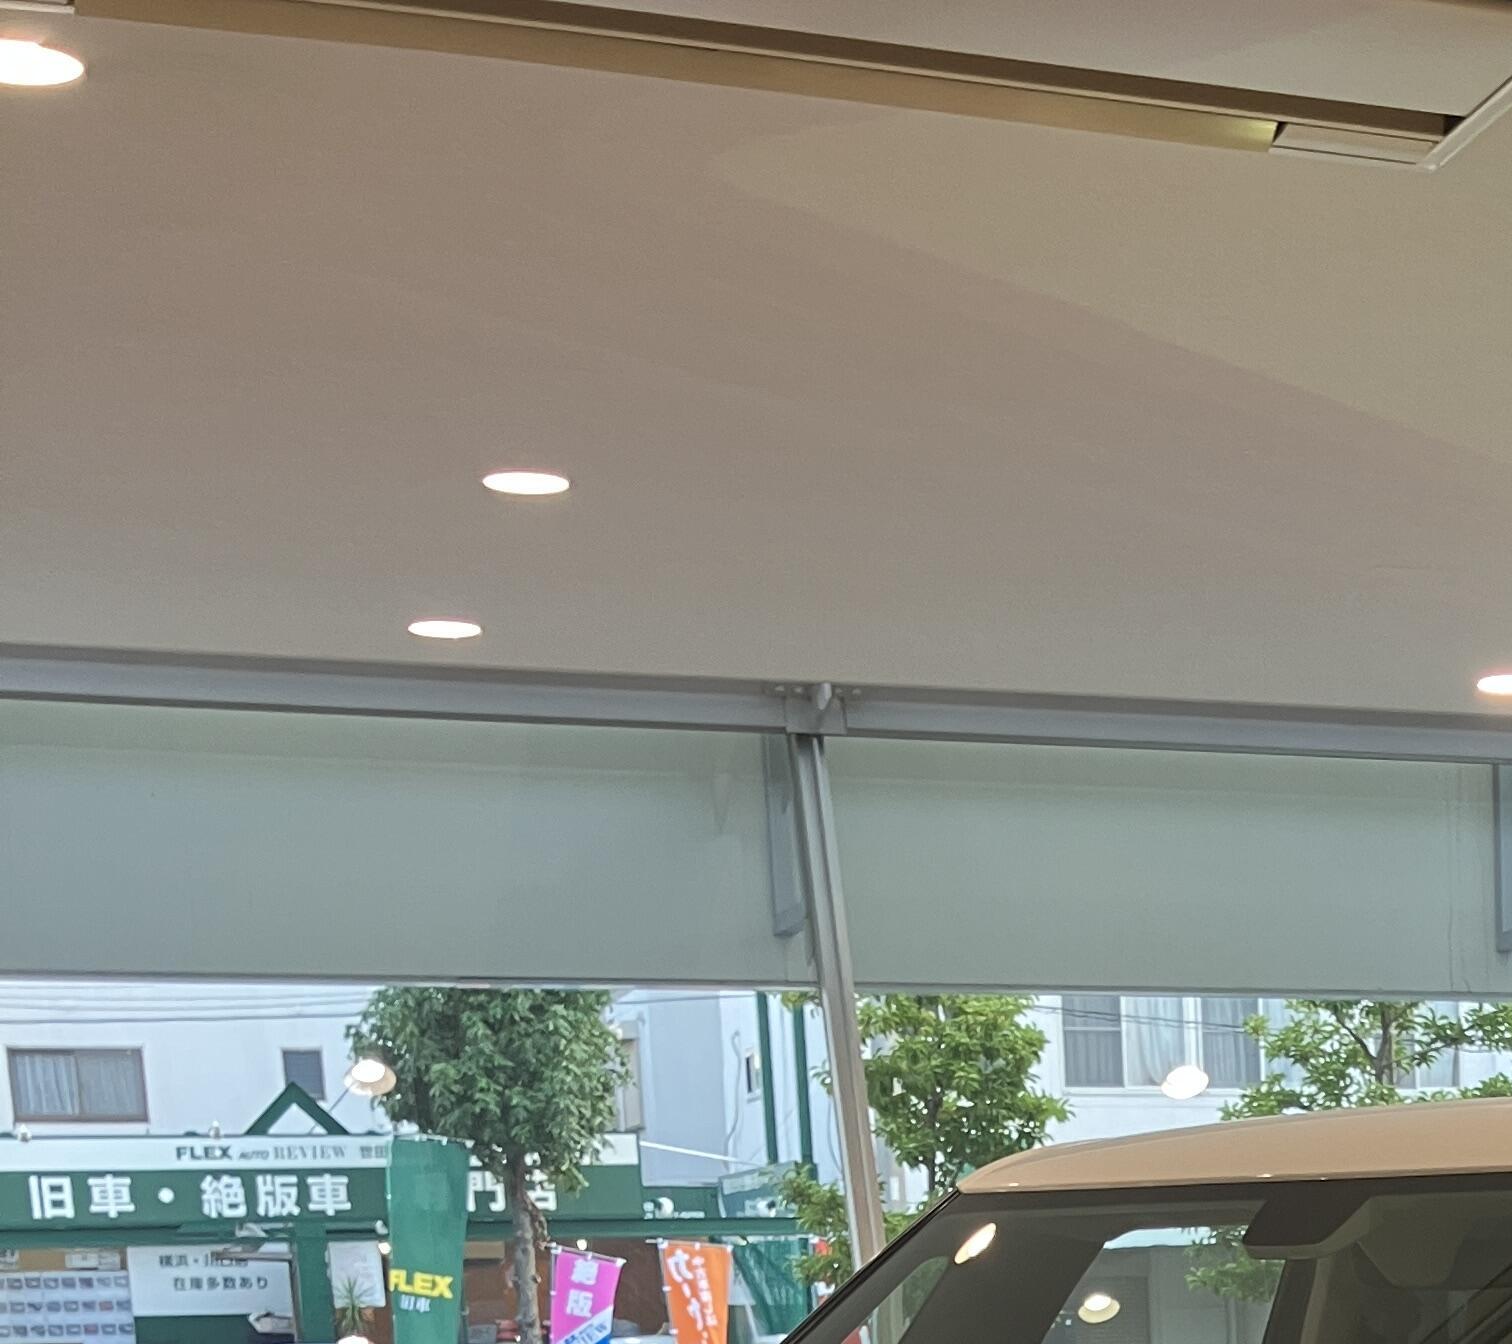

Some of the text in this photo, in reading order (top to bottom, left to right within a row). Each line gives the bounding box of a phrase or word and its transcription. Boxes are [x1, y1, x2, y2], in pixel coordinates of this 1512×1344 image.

[176, 1145, 232, 1160] FLEX
[273, 1145, 348, 1160] REVIEW
[389, 1268, 454, 1299] FLEX
